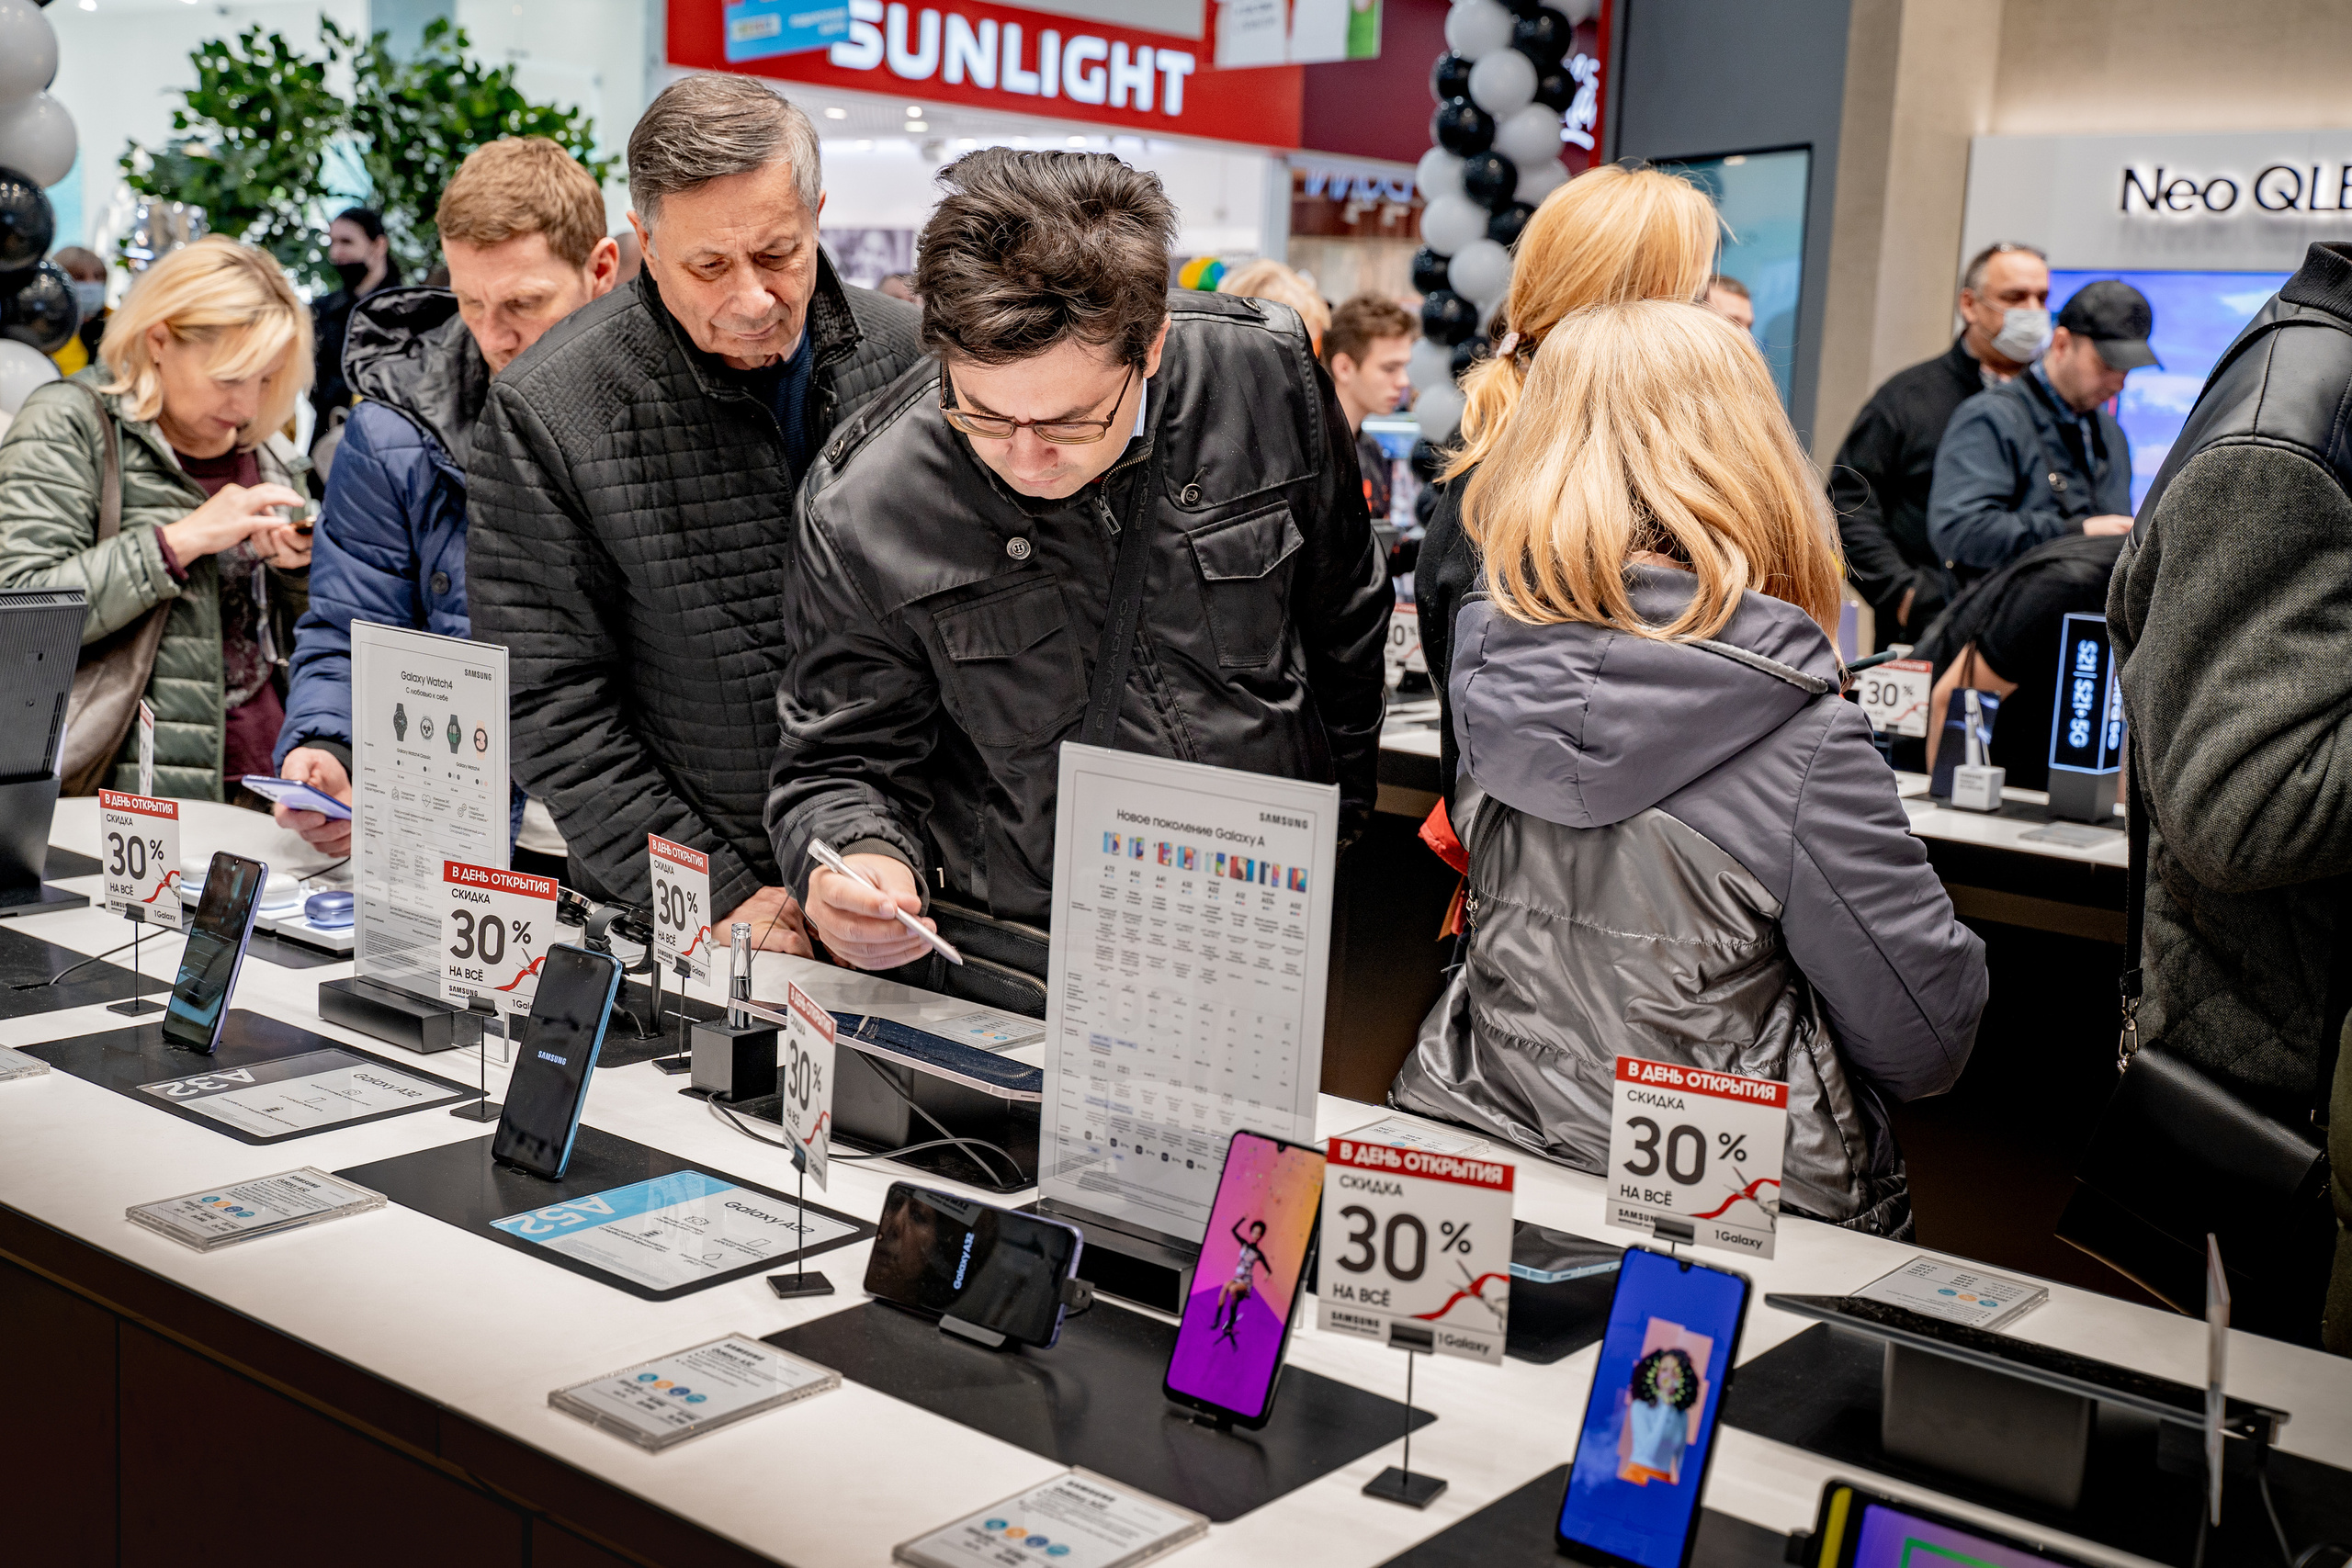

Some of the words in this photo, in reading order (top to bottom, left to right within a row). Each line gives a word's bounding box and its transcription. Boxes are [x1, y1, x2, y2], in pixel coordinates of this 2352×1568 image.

[830, 0, 1195, 117] SUNLIGHT
[2120, 167, 2239, 212] Neo
[401, 671, 425, 685] Galaxy
[426, 675, 453, 690] Watch4
[464, 669, 492, 682] SAMSUNG
[411, 689, 432, 699] любовью
[1867, 681, 1897, 706] 30
[105, 794, 110, 805] В
[111, 795, 130, 807] ДЕНЬ
[131, 798, 174, 814] ОТКРЫТИЯ
[106, 813, 133, 826] СКИДКА
[1117, 809, 1150, 825] Новое
[1153, 818, 1213, 837] поколение
[1216, 828, 1256, 847] Galaxy
[1259, 812, 1308, 829] SAMSUNG
[107, 831, 146, 880] 30
[652, 840, 657, 851] В
[657, 843, 672, 856] ДЕНЬ
[673, 847, 704, 868] ОТКРЫТИЯ
[654, 860, 674, 875] СКИДКА
[110, 883, 119, 893] НА
[121, 885, 134, 896] ВСЁ
[452, 866, 459, 878] В
[460, 868, 489, 883] ДЕНЬ
[491, 874, 549, 894] ОТКРЫТИЯ
[451, 888, 491, 904] СКИДКА
[656, 879, 685, 931] 30
[450, 909, 505, 964] 30
[658, 930, 665, 942] НА
[449, 965, 462, 978] НА
[465, 967, 483, 982] ВСЁ
[690, 964, 706, 979] Galaxy
[448, 985, 479, 997] SAMSUNG
[512, 998, 533, 1010] 1Gal
[537, 1050, 567, 1066] SAMSUNG
[151, 1068, 257, 1098] A32
[353, 1072, 398, 1095] Galaxy
[394, 1086, 424, 1099] A32
[788, 1039, 810, 1111] 30
[1628, 1062, 1639, 1077] В
[1641, 1065, 1683, 1085] ДЕНЬ
[1686, 1072, 1776, 1100] ОТКРЫТИЯ
[1627, 1090, 1685, 1111] СКИДКА
[1623, 1116, 1707, 1186] 30
[1340, 1142, 1353, 1160] В
[1353, 1146, 1402, 1168] ДЕНЬ
[1403, 1152, 1504, 1184] ОТКРЫТИЯ
[289, 1175, 321, 1189] SAMSUNG
[1340, 1174, 1404, 1197] СКИДКА
[1621, 1184, 1640, 1201] НА
[1645, 1187, 1672, 1206] ВСЁ
[510, 1196, 616, 1235] A52
[724, 1201, 786, 1225] Galaxy
[1618, 1209, 1657, 1223] SAMSUN
[1337, 1205, 1427, 1281] 30
[1714, 1230, 1763, 1250] 1Galaxy
[953, 1250, 971, 1291] Galaxy
[1332, 1284, 1353, 1302] НА
[1359, 1288, 1391, 1307] ВСЁ
[1331, 1311, 1380, 1328] SAMSUNG
[1438, 1332, 1491, 1356] 1Galaxy
